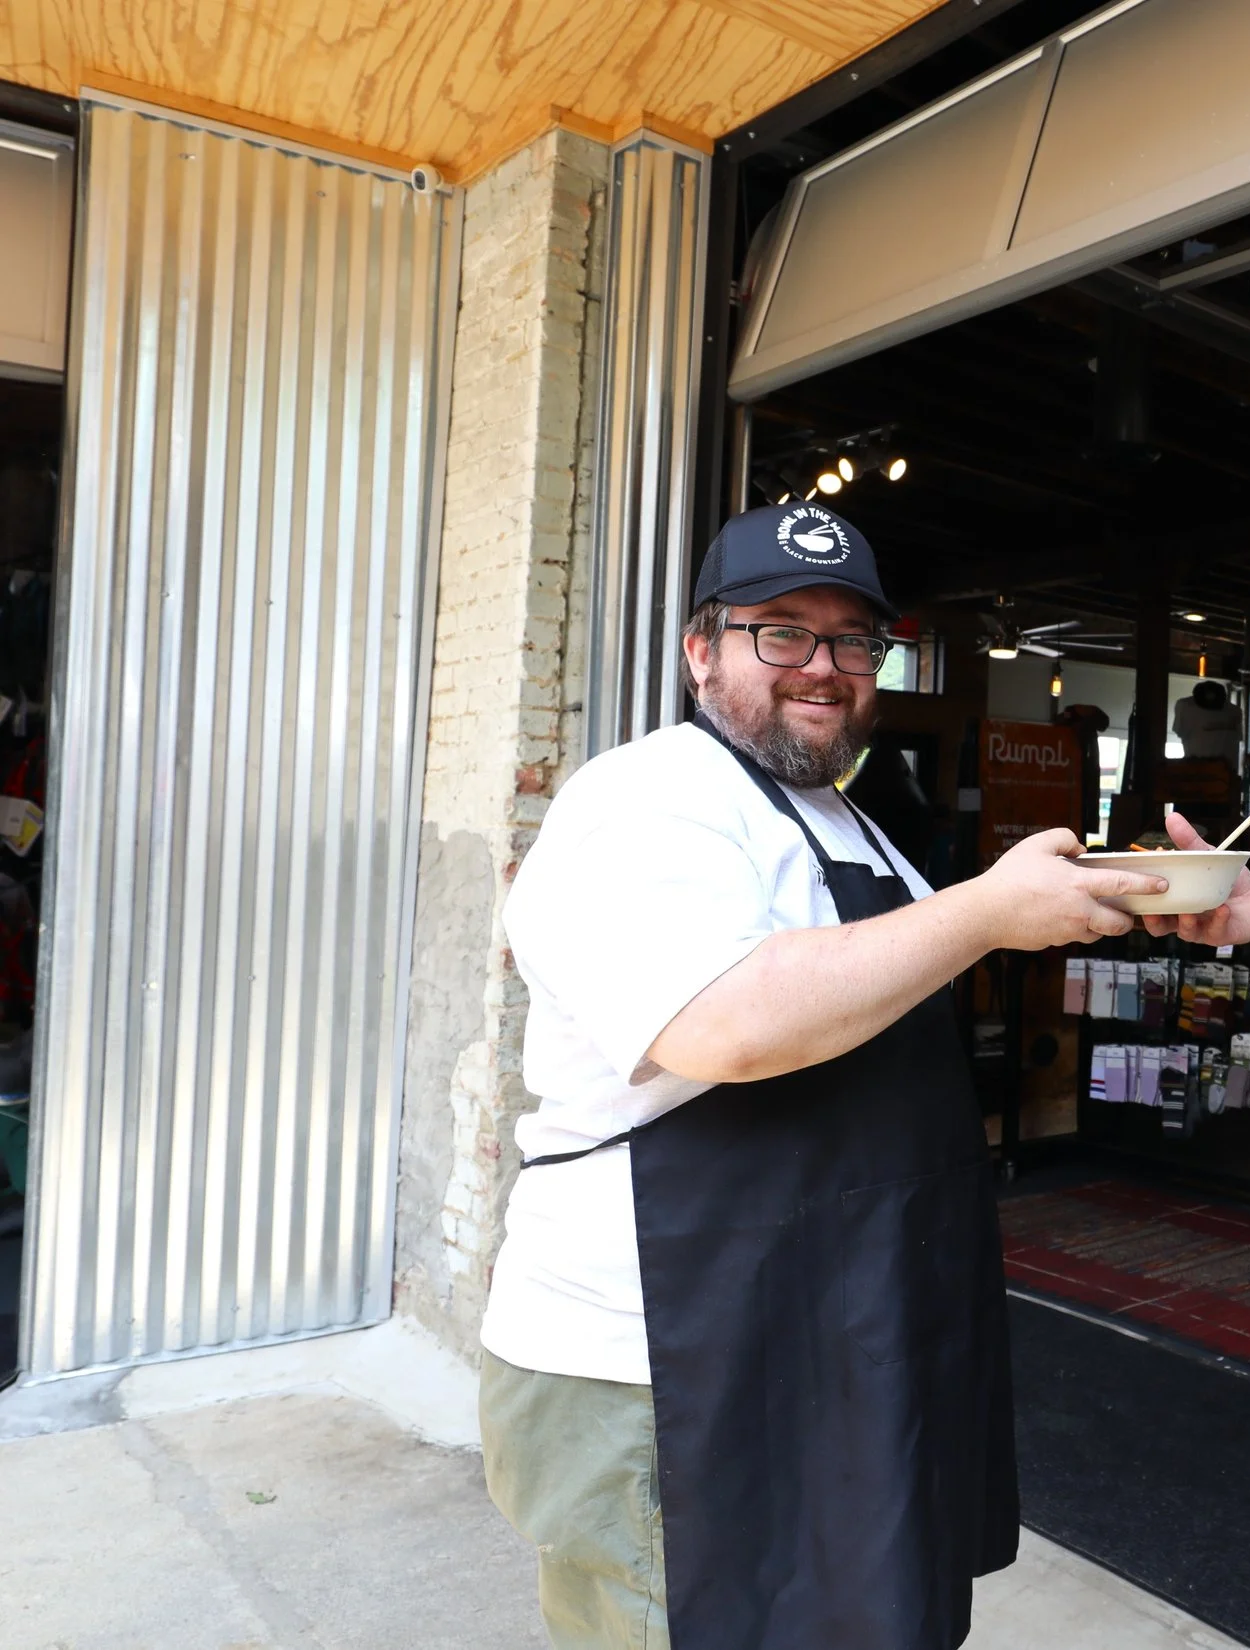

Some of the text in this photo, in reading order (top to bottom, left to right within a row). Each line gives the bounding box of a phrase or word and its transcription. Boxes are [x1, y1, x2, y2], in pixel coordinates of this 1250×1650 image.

[777, 508, 850, 547] BOWL IN THE WALL
[783, 545, 804, 560] BLACK
[988, 733, 1070, 772] Rumpl
